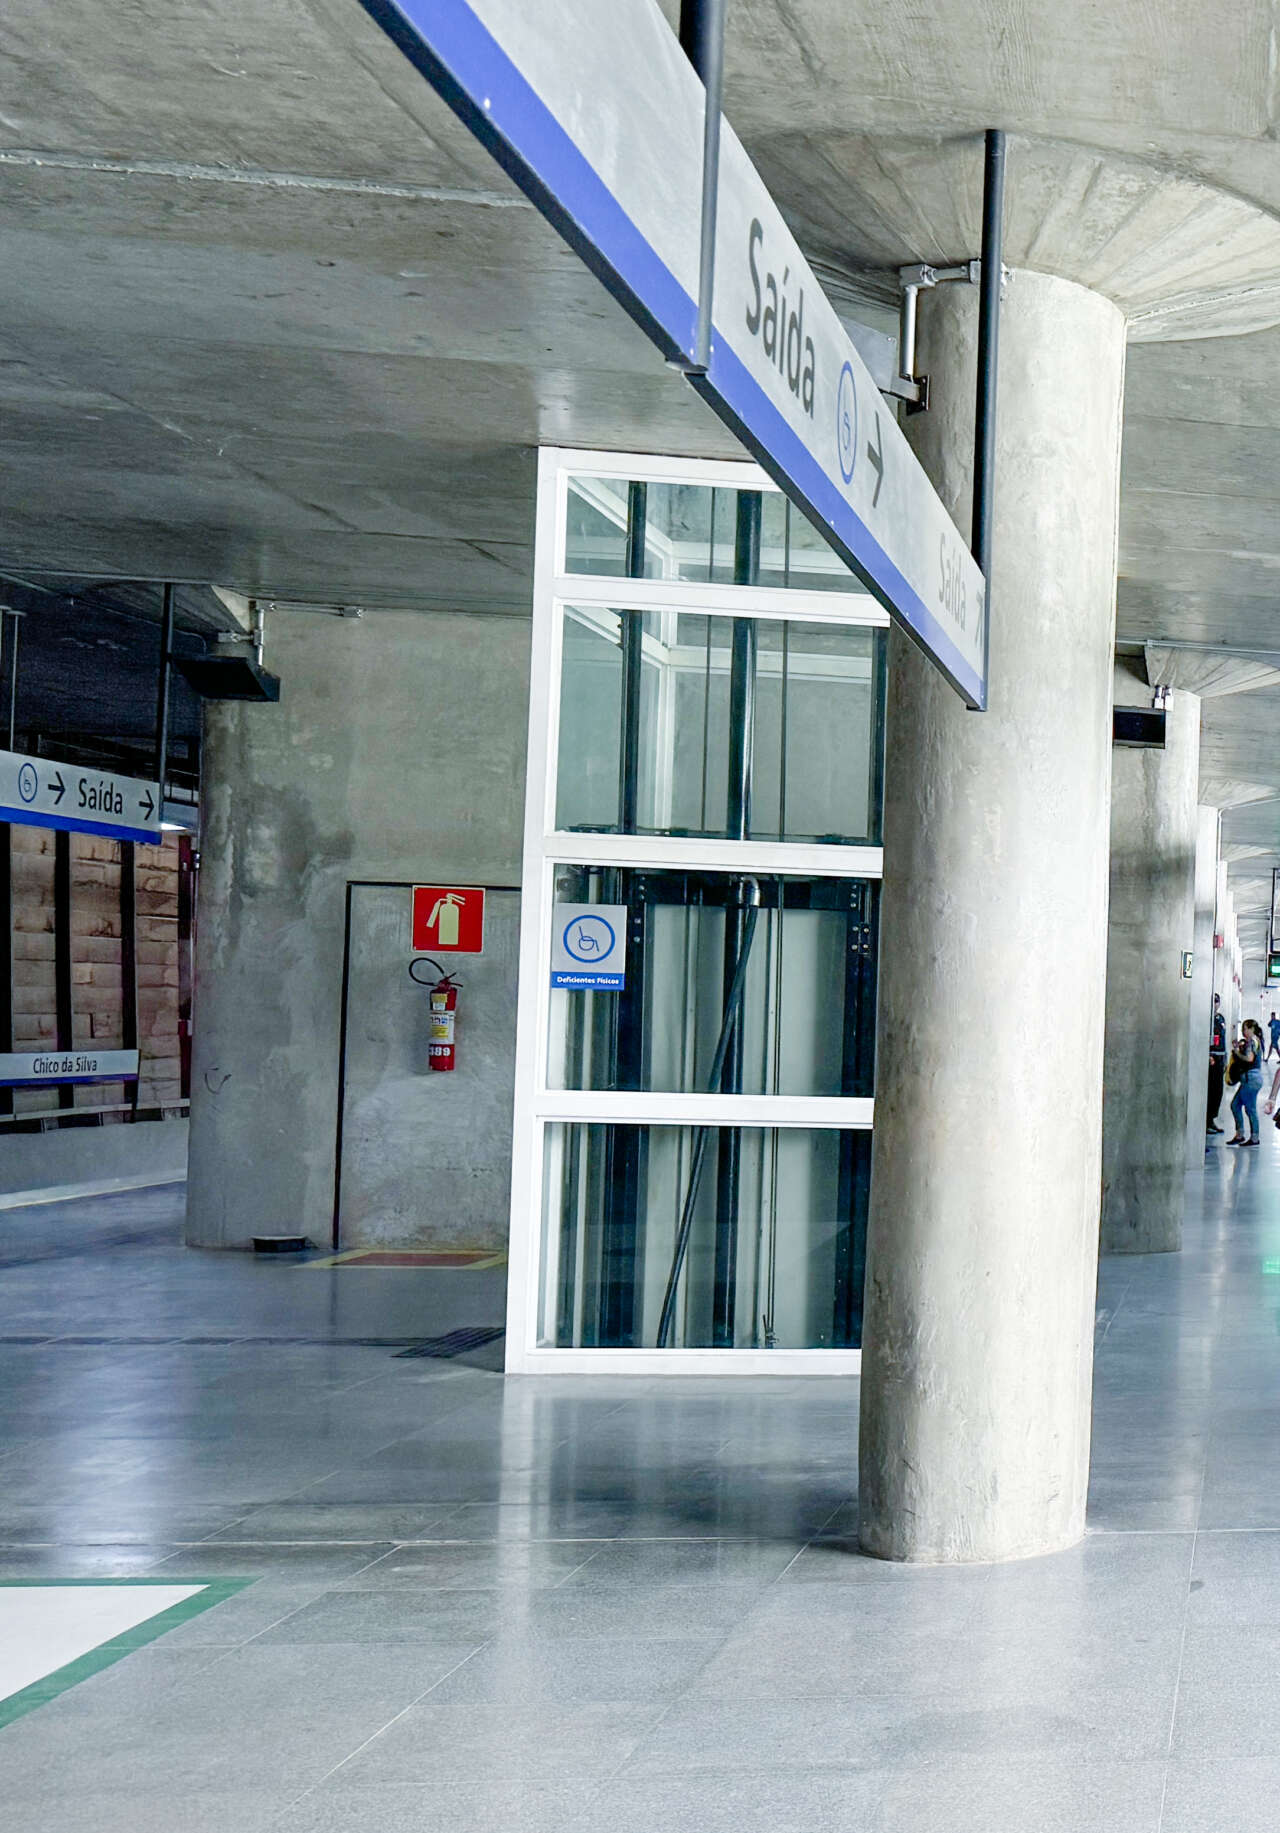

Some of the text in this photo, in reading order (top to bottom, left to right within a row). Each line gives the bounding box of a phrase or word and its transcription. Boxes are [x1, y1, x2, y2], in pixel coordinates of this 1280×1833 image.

[746, 217, 815, 421] Saída
[938, 532, 966, 633] Saída
[78, 778, 123, 815] Saída
[556, 975, 619, 985] Deficientes Físicos
[33, 1055, 98, 1074] Chico da Silva
